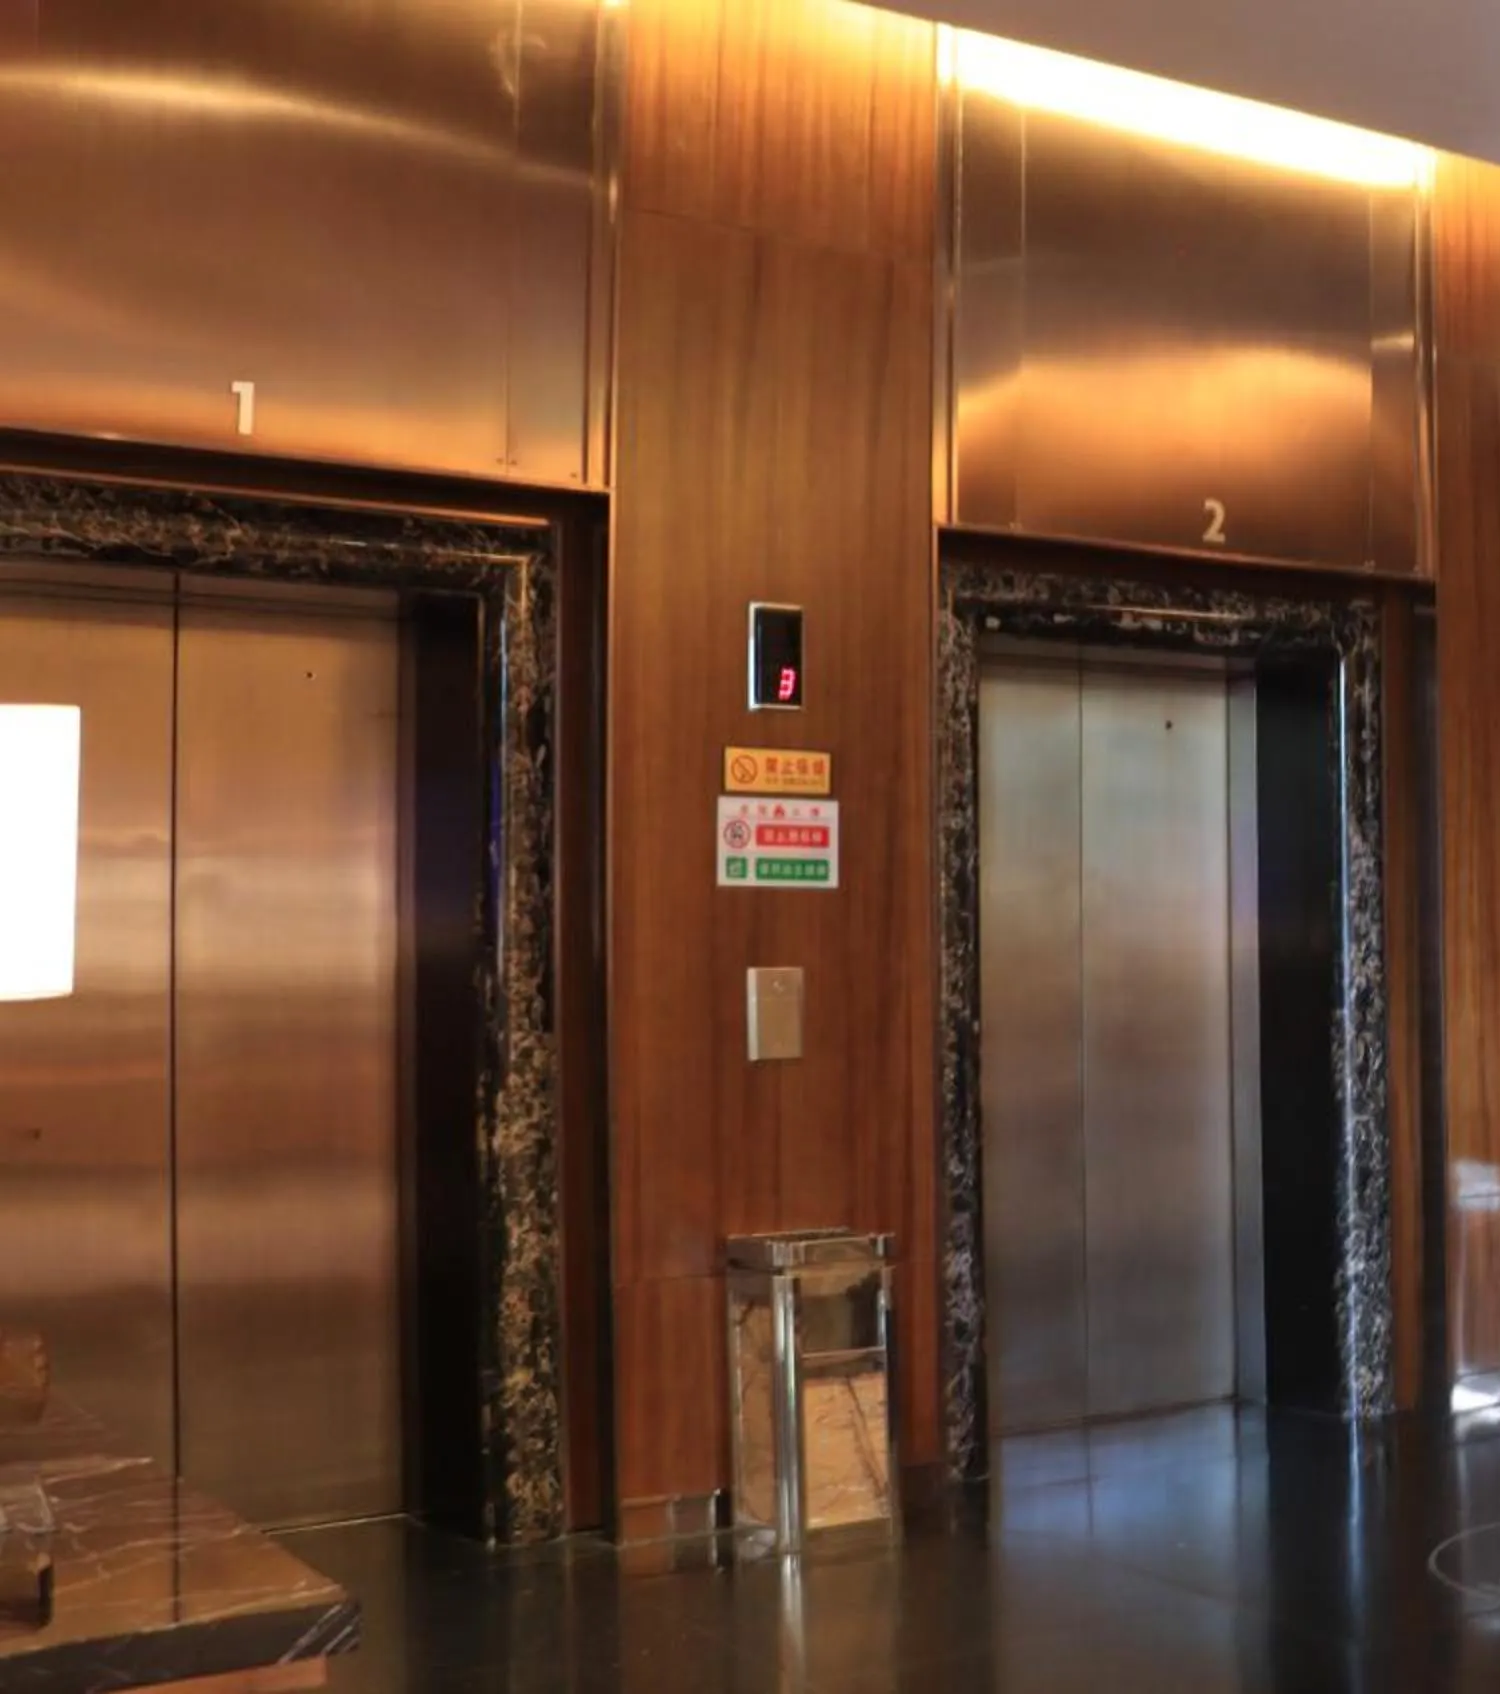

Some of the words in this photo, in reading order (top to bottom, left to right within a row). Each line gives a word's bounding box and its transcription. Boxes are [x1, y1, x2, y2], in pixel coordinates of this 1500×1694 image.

[231, 380, 254, 435] 1
[1202, 498, 1226, 543] 2
[779, 668, 796, 700] 3
